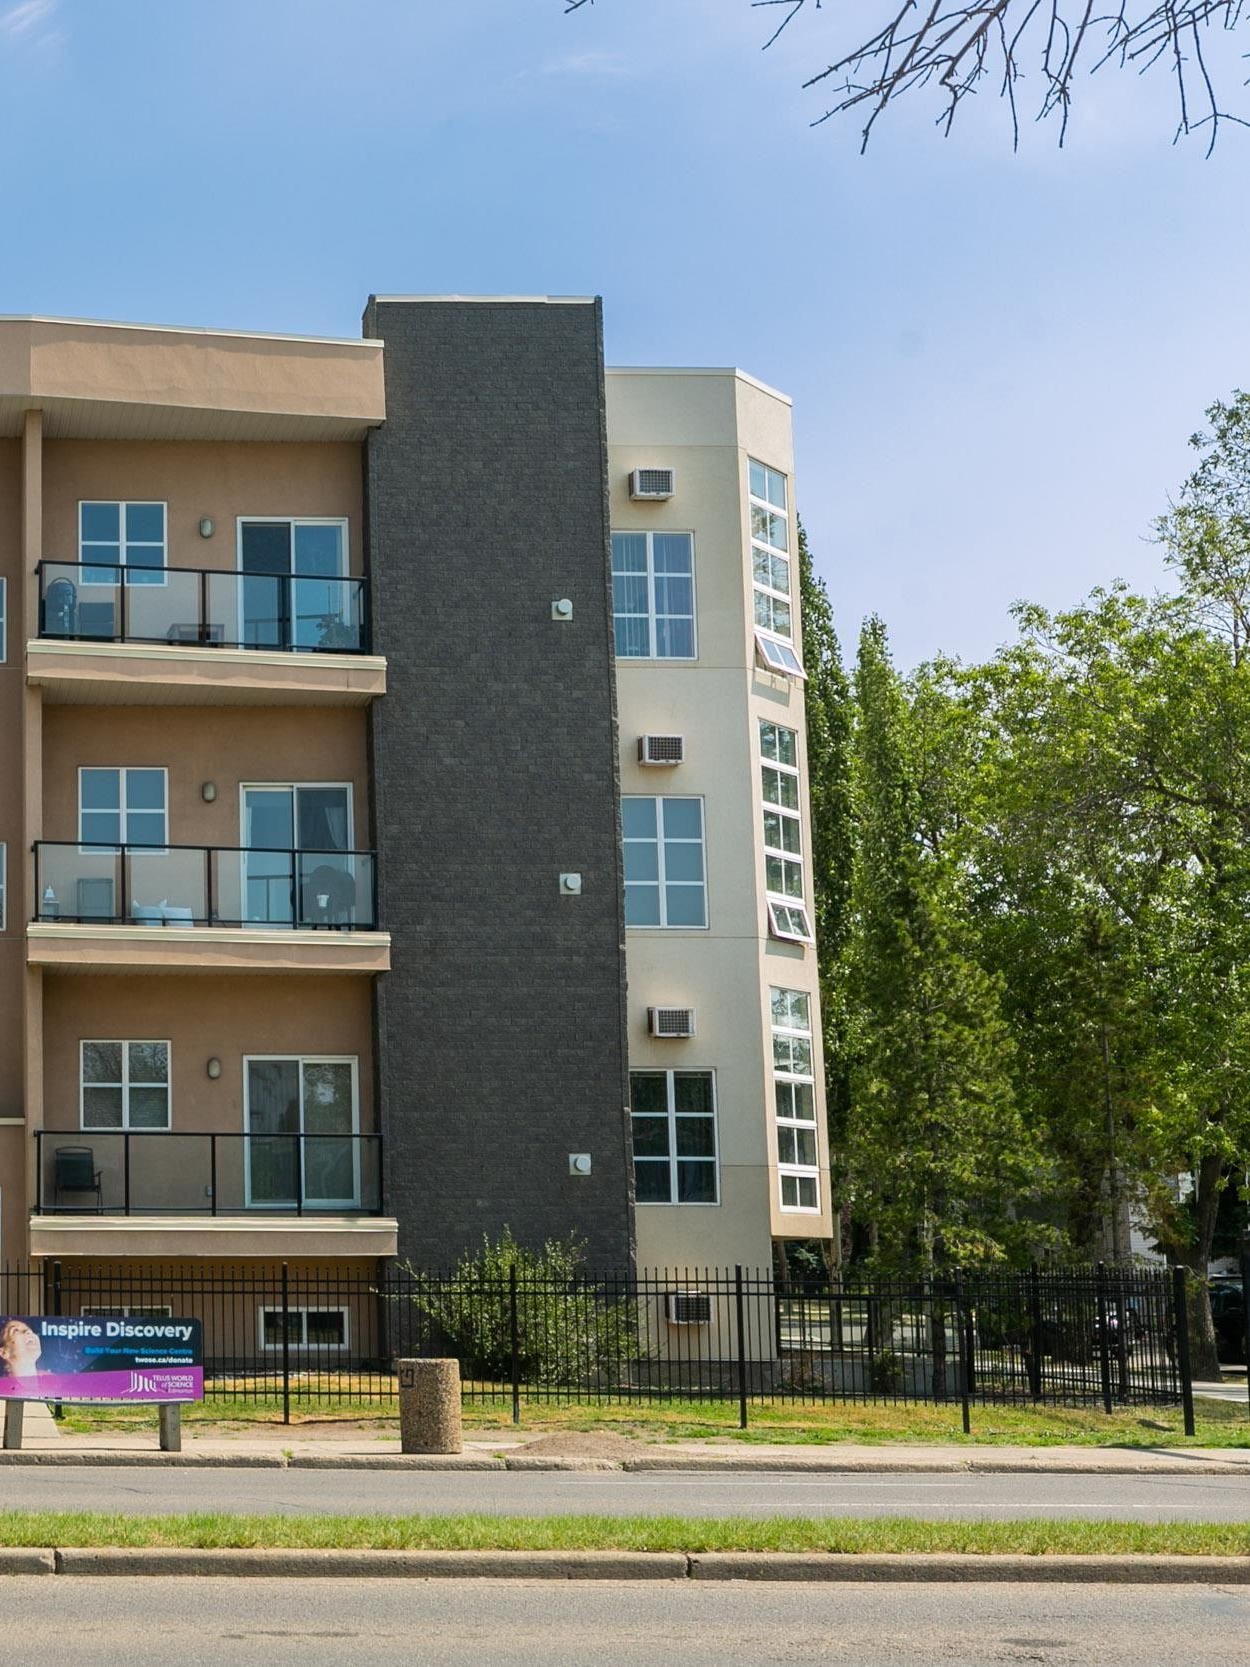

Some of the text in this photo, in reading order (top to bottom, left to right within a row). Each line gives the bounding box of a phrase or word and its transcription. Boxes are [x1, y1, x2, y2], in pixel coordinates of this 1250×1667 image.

[41, 1321, 193, 1341] Inspire Discovery
[140, 1347, 167, 1355] Science
